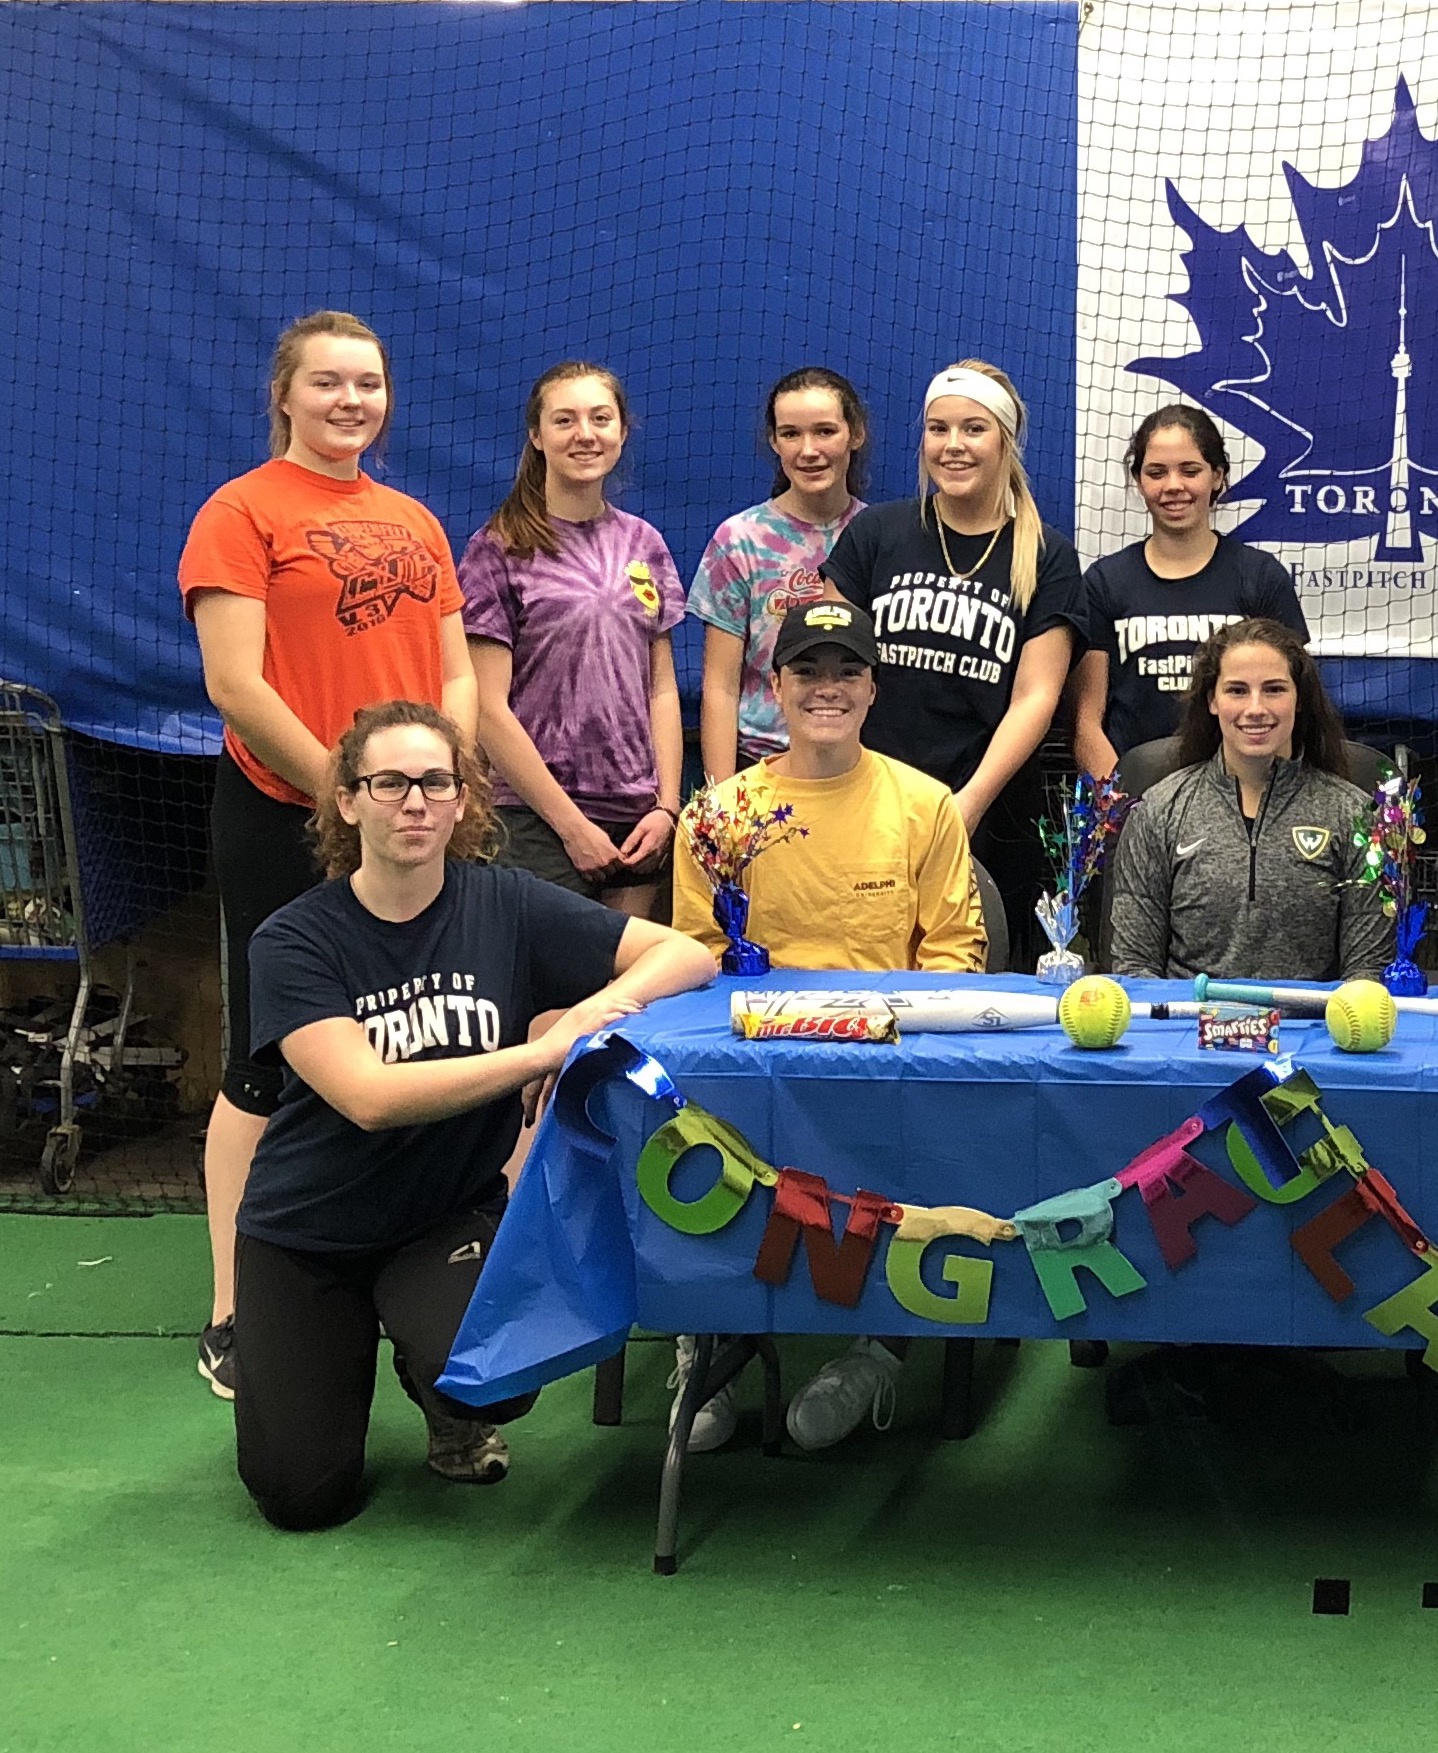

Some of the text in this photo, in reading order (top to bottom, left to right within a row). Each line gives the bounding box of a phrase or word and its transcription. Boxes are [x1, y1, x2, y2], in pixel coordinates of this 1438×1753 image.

[890, 571, 1010, 608] PROPERTY OF
[871, 588, 1017, 665] TORONTO
[958, 655, 1001, 684] CLUB
[1138, 655, 1192, 676] FastPi
[1158, 676, 1194, 691] CLU
[853, 879, 895, 891] ADELPHI
[452, 972, 475, 991] OF
[359, 995, 500, 1064] ORONTO
